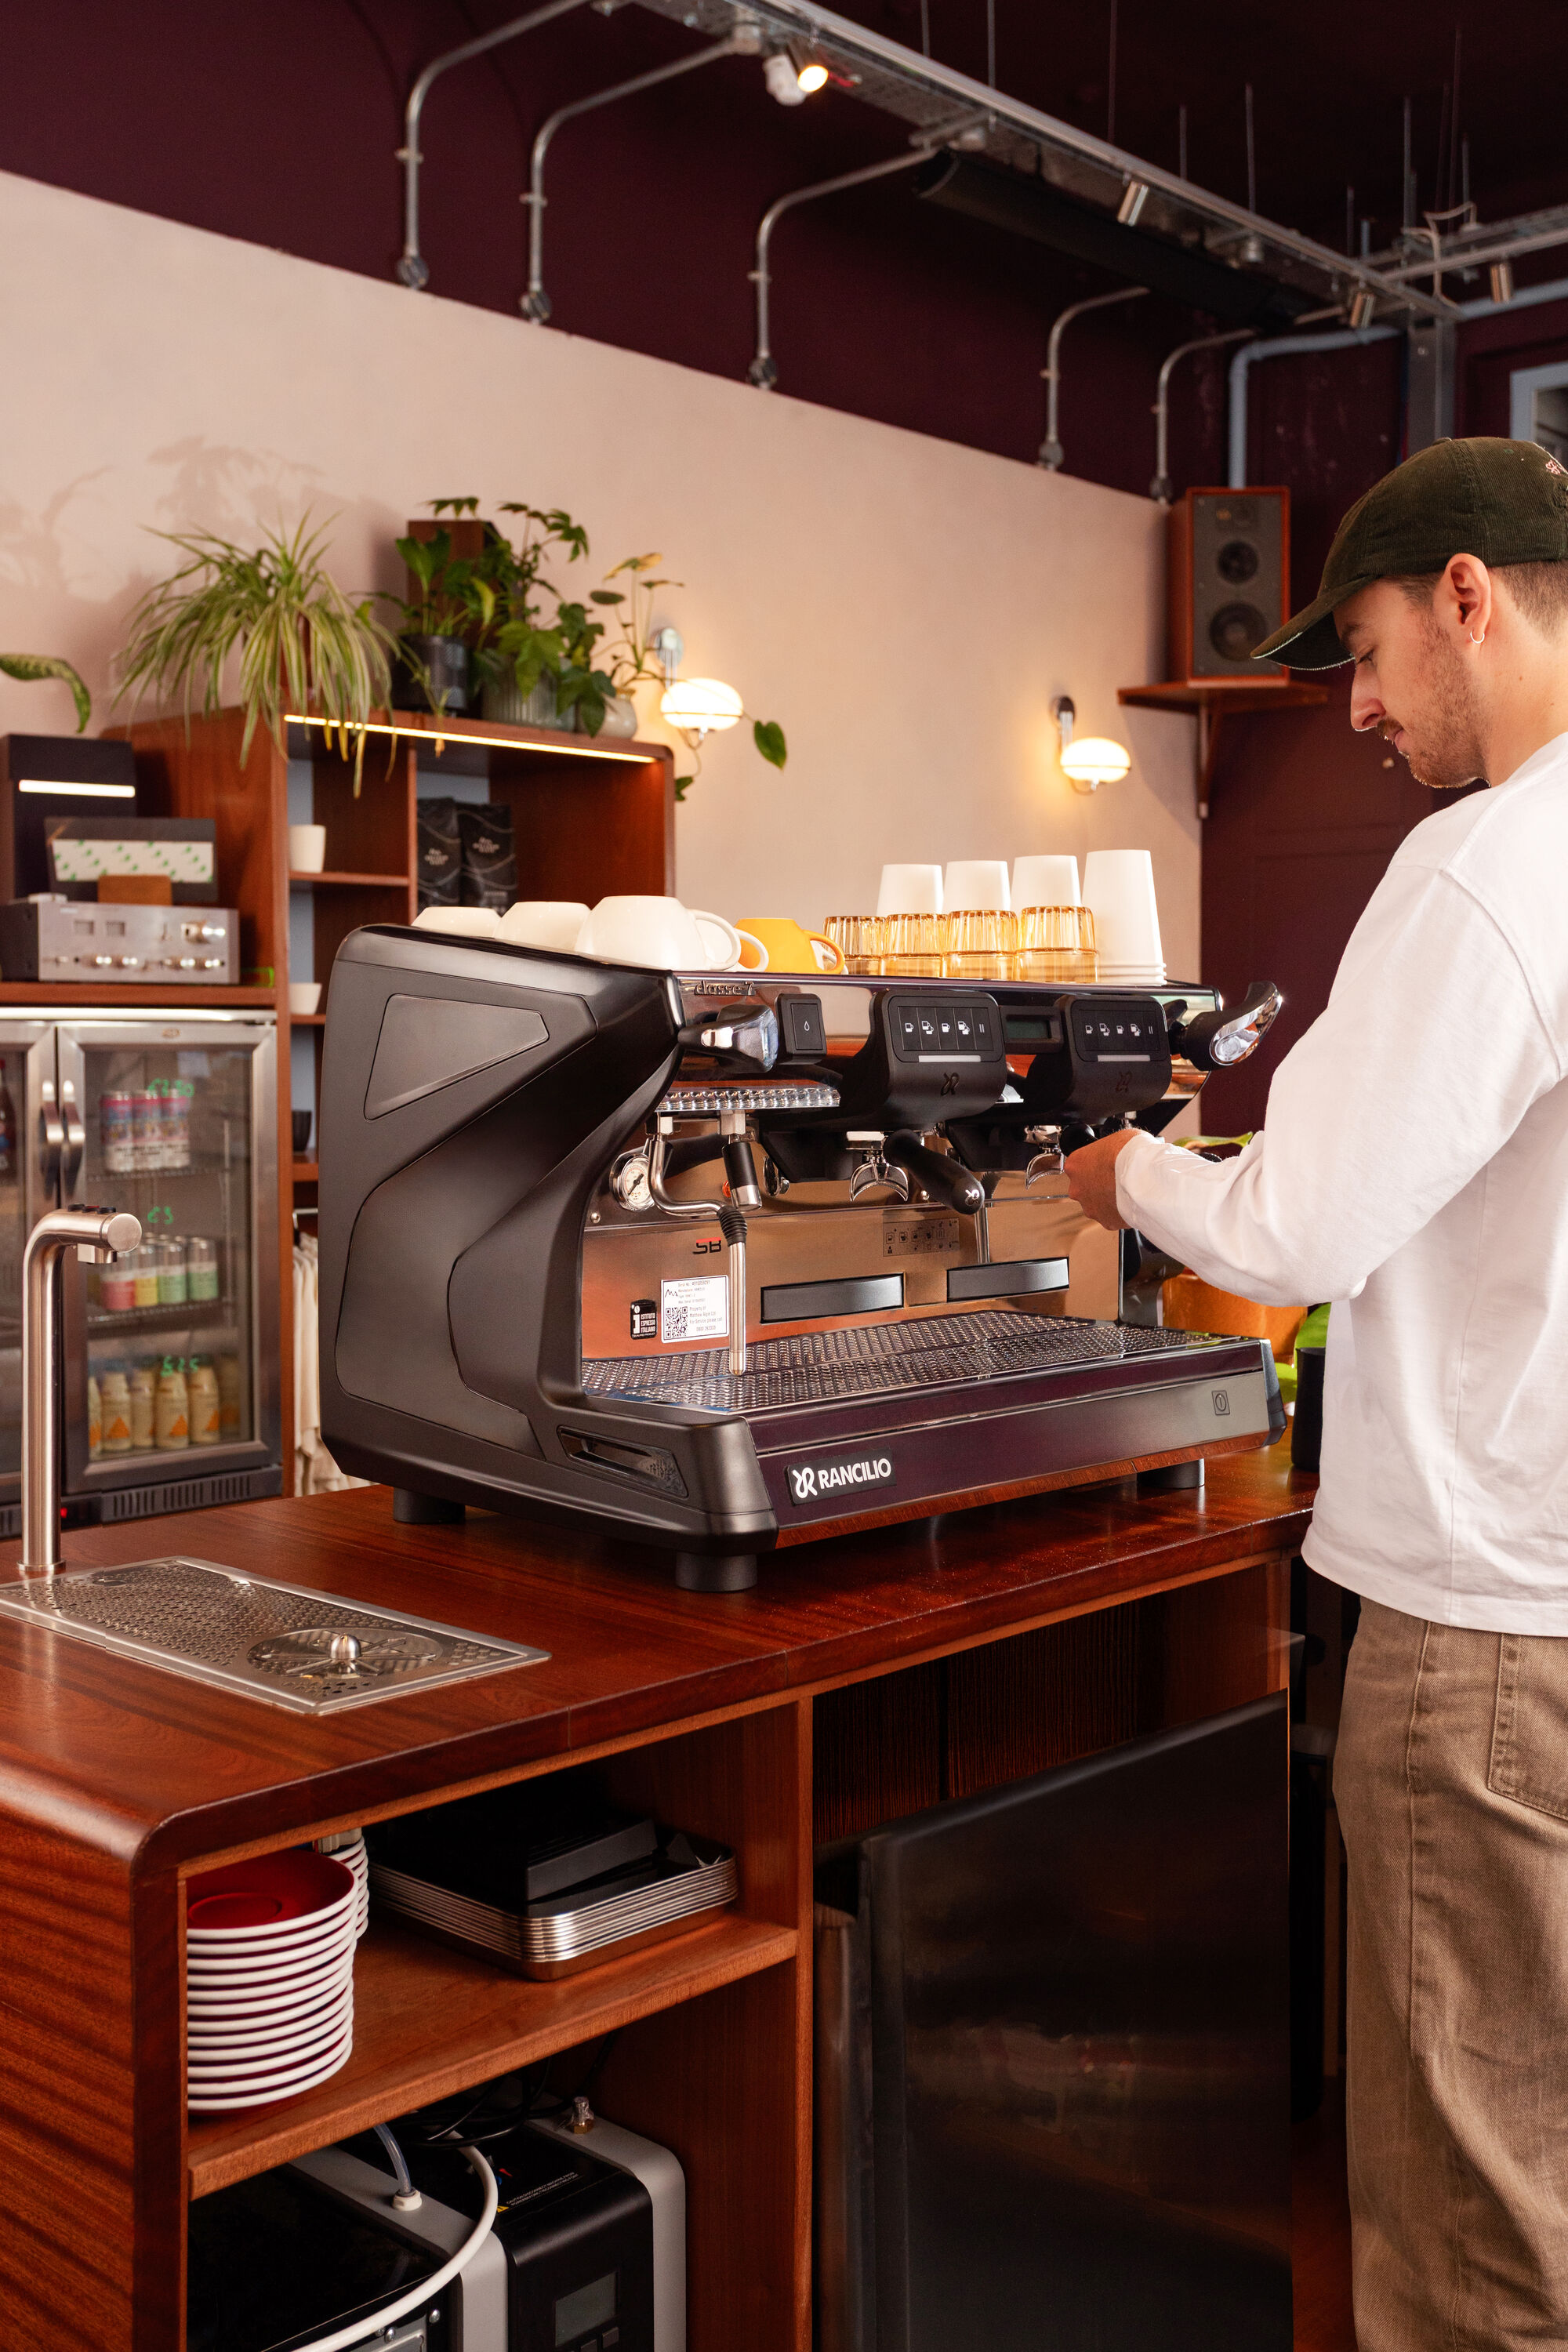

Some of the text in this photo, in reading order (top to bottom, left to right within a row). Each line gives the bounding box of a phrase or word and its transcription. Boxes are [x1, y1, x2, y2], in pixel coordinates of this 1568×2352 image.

[695, 980, 754, 996] classe 7
[818, 1457, 891, 1490] RANCILIO
